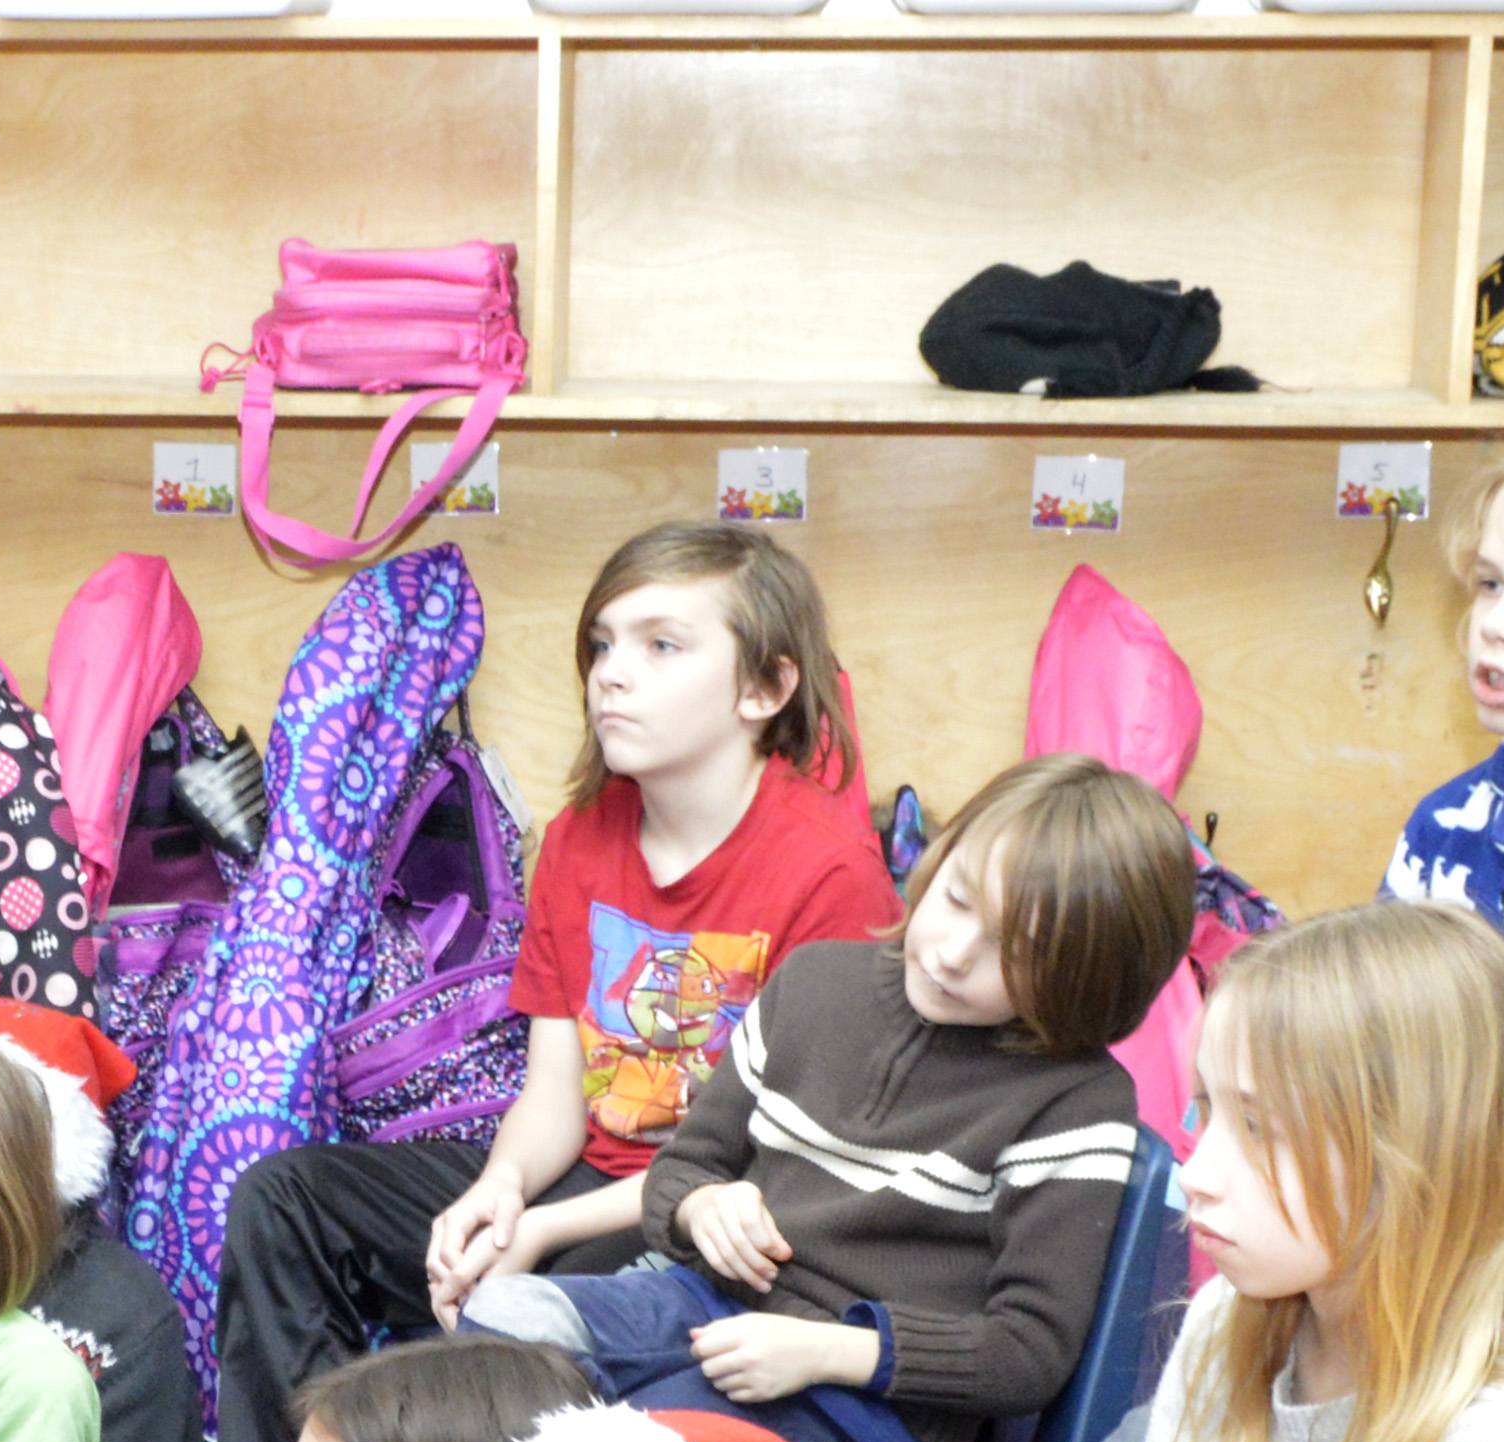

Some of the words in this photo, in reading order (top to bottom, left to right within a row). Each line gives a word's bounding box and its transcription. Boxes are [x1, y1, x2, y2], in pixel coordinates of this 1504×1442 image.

[185, 457, 205, 482] 1
[756, 466, 773, 487] 3
[1372, 462, 1389, 481] 5
[1072, 472, 1087, 494] 4
